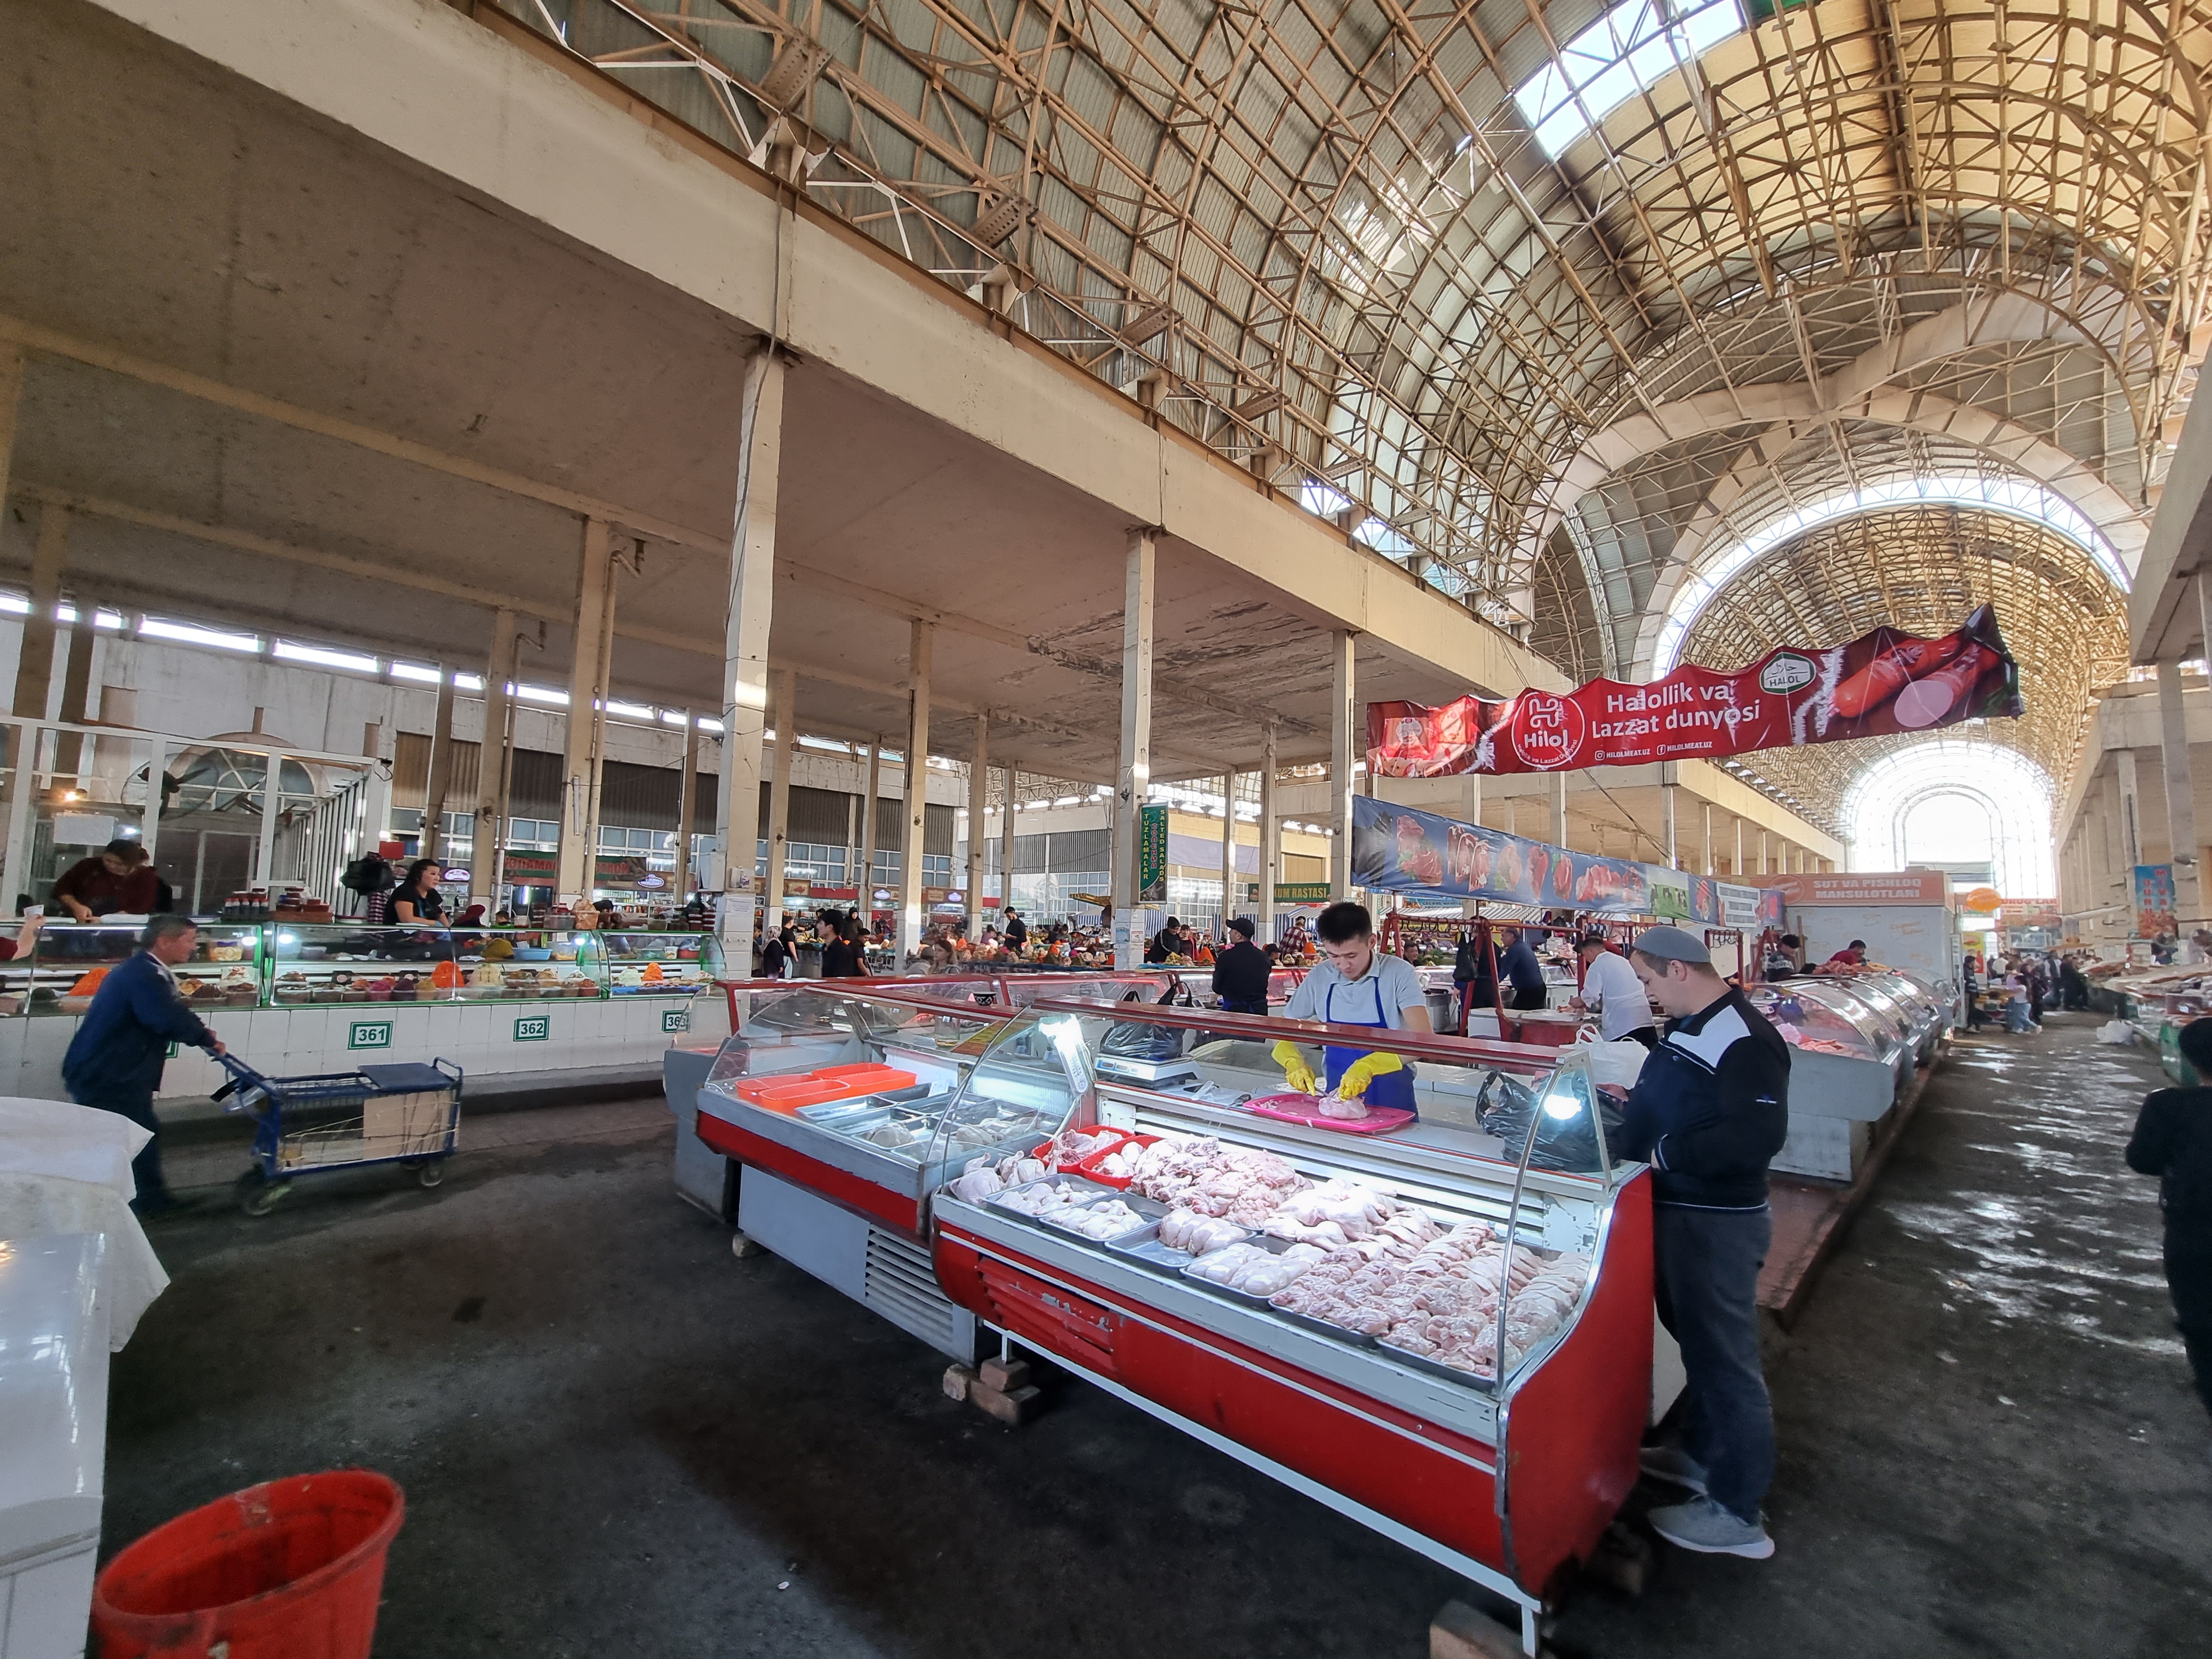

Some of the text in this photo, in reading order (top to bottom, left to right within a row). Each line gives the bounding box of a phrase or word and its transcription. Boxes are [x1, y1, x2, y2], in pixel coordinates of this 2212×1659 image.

[1770, 675, 1801, 686] HALOL
[1607, 682, 1730, 713] Halollik va
[1592, 699, 1760, 739] Lazzat dunyosi
[1524, 729, 1568, 748] Hilol
[1667, 742, 1713, 752] HILOLMEAT.UZ
[1606, 748, 1651, 758] HILOLMEAT.UZ
[1813, 878, 1922, 888] SUT VA PISHLOQ
[1292, 888, 1327, 898] RASTASI
[1815, 889, 1920, 899] MAHSULOTLARI
[667, 1016, 686, 1027] 363
[521, 1022, 544, 1035] 362
[358, 1029, 385, 1041] 361
